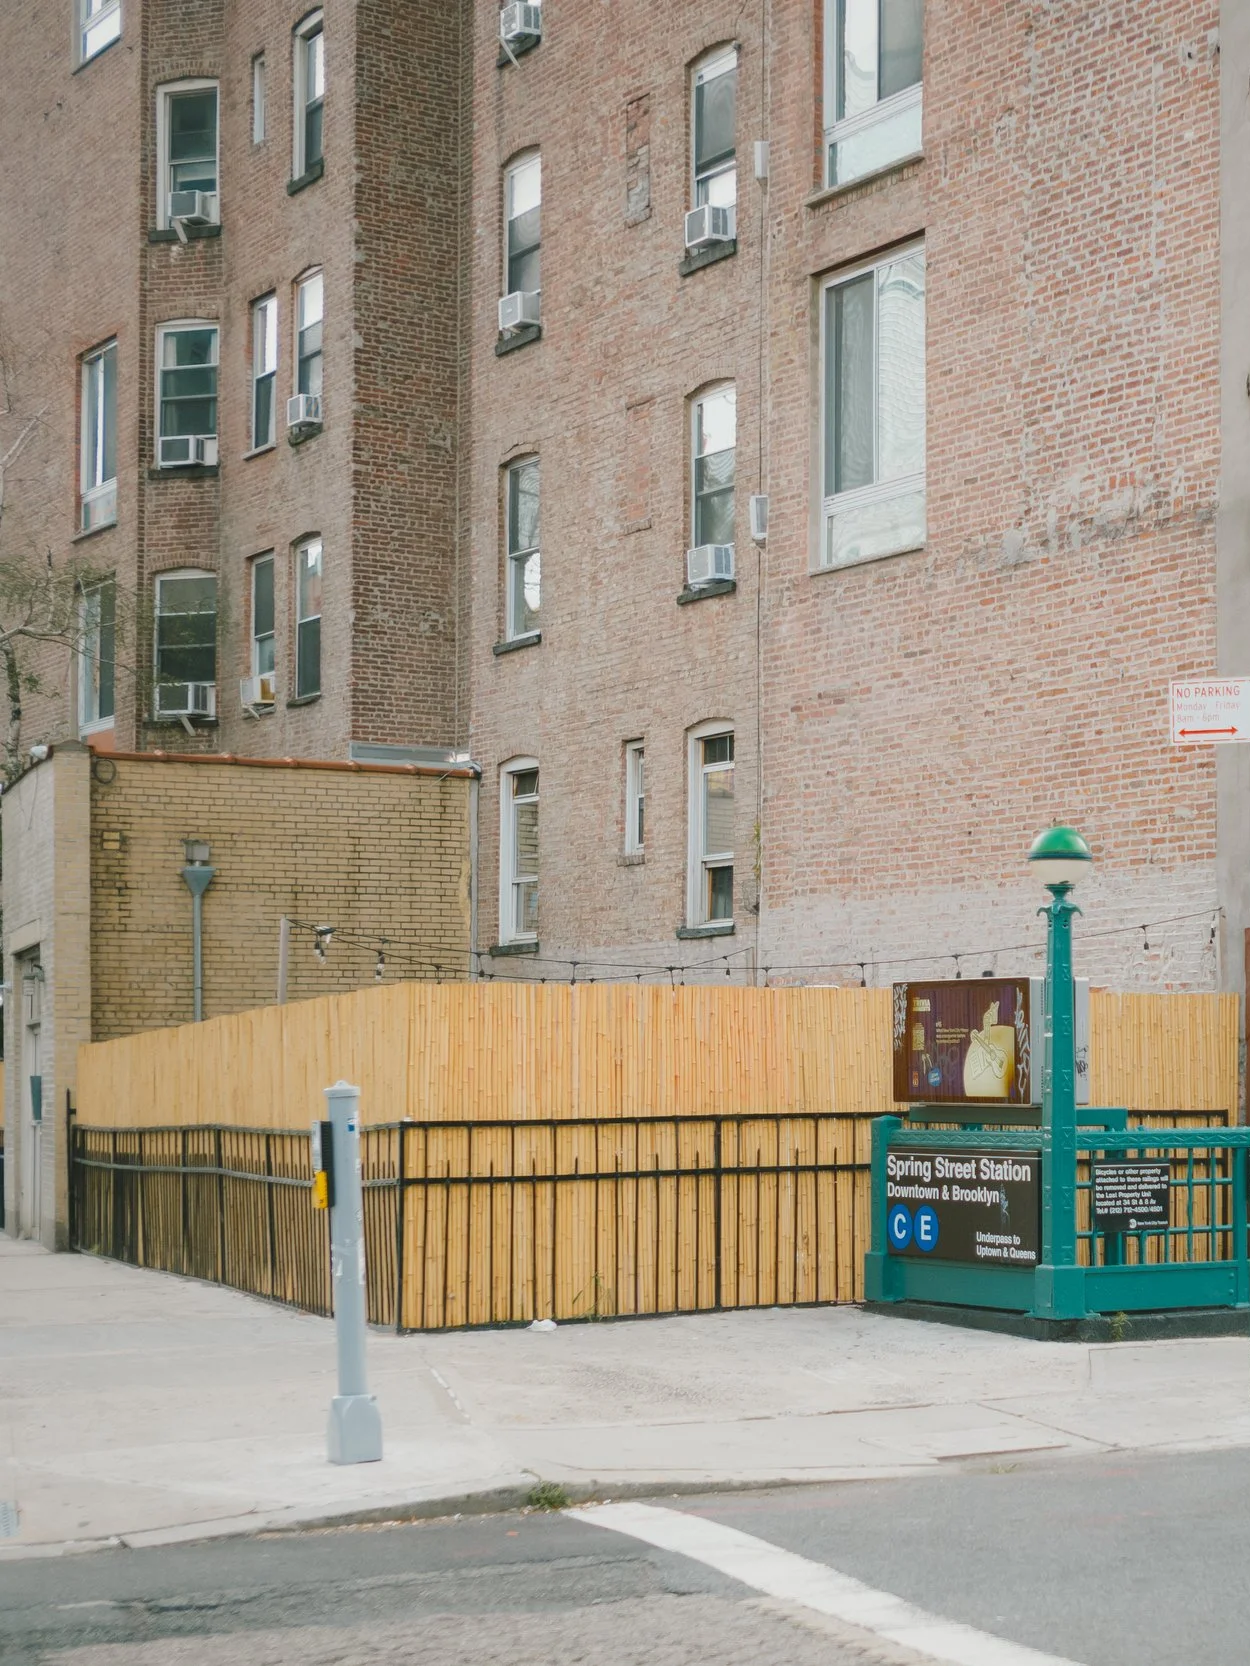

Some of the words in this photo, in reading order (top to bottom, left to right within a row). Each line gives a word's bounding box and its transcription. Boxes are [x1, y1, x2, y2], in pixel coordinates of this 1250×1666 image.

[1176, 687, 1191, 698] NO
[1194, 685, 1240, 697] PARKING
[1176, 702, 1207, 711] Monday
[1215, 700, 1240, 711] Friday
[887, 1155, 932, 1183] Spring
[935, 1156, 977, 1180] Street
[980, 1158, 1031, 1182] Station
[887, 1182, 940, 1200] Downtown
[942, 1185, 950, 1200] &
[952, 1185, 1000, 1207] Brooklyn
[893, 1213, 907, 1239] C
[920, 1215, 932, 1241] E
[976, 1231, 1012, 1246] Underpass
[1013, 1234, 1021, 1245] to
[976, 1245, 1002, 1257] Uptown
[1002, 1247, 1008, 1257] &
[1009, 1247, 1036, 1260] Queens
